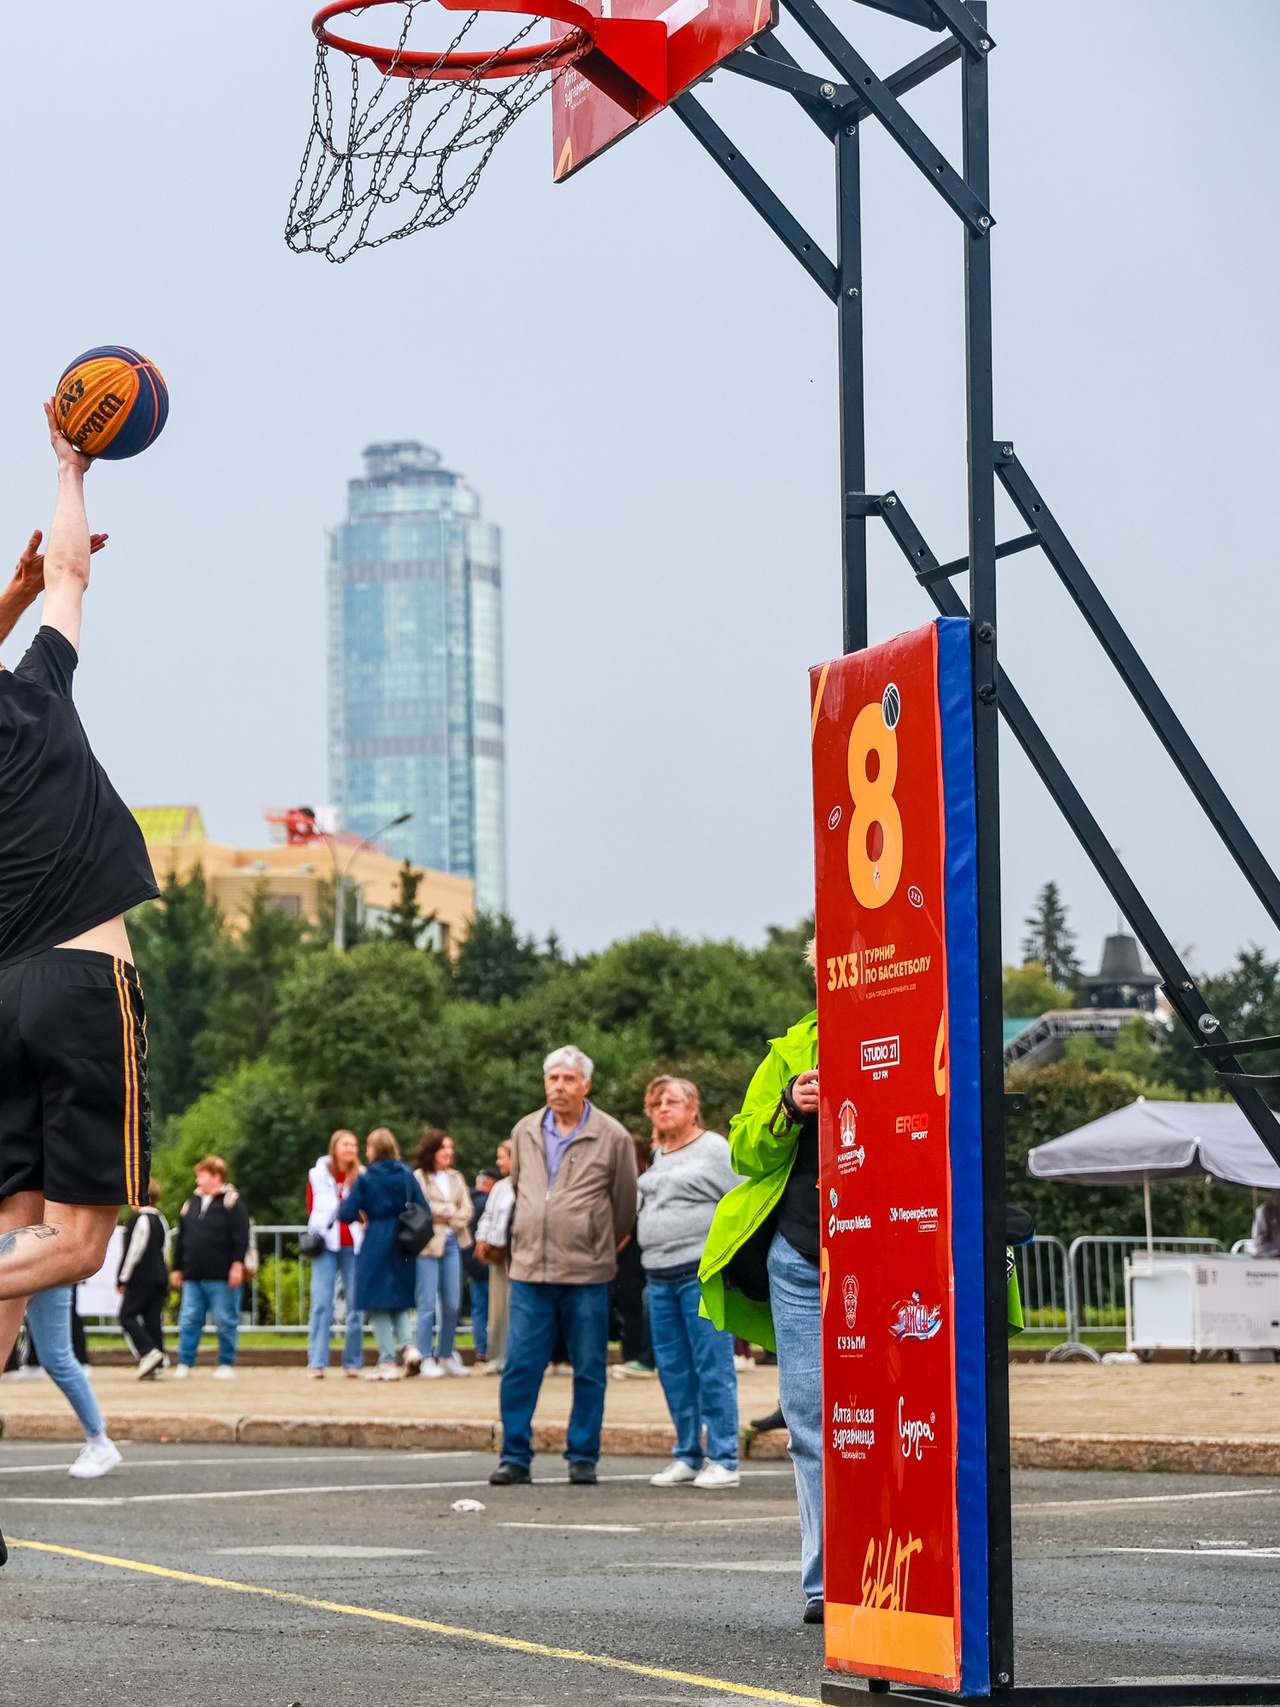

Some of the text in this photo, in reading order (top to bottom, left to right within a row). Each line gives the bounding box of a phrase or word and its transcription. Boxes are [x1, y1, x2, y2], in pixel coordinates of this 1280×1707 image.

[848, 702, 903, 910] 8
[865, 943, 896, 965] ТУРНИР
[826, 952, 859, 992] 3X3
[865, 955, 931, 984] ПО БАСКЕТБОЛУ
[863, 1042, 897, 1063] STUDIO 21
[895, 1113, 929, 1134] ERGO
[911, 1130, 929, 1140] SPORT
[898, 1206, 939, 1223] Перекрёсток
[837, 1335, 866, 1350] КУЗЬМА
[832, 1394, 875, 1424] Алтайская
